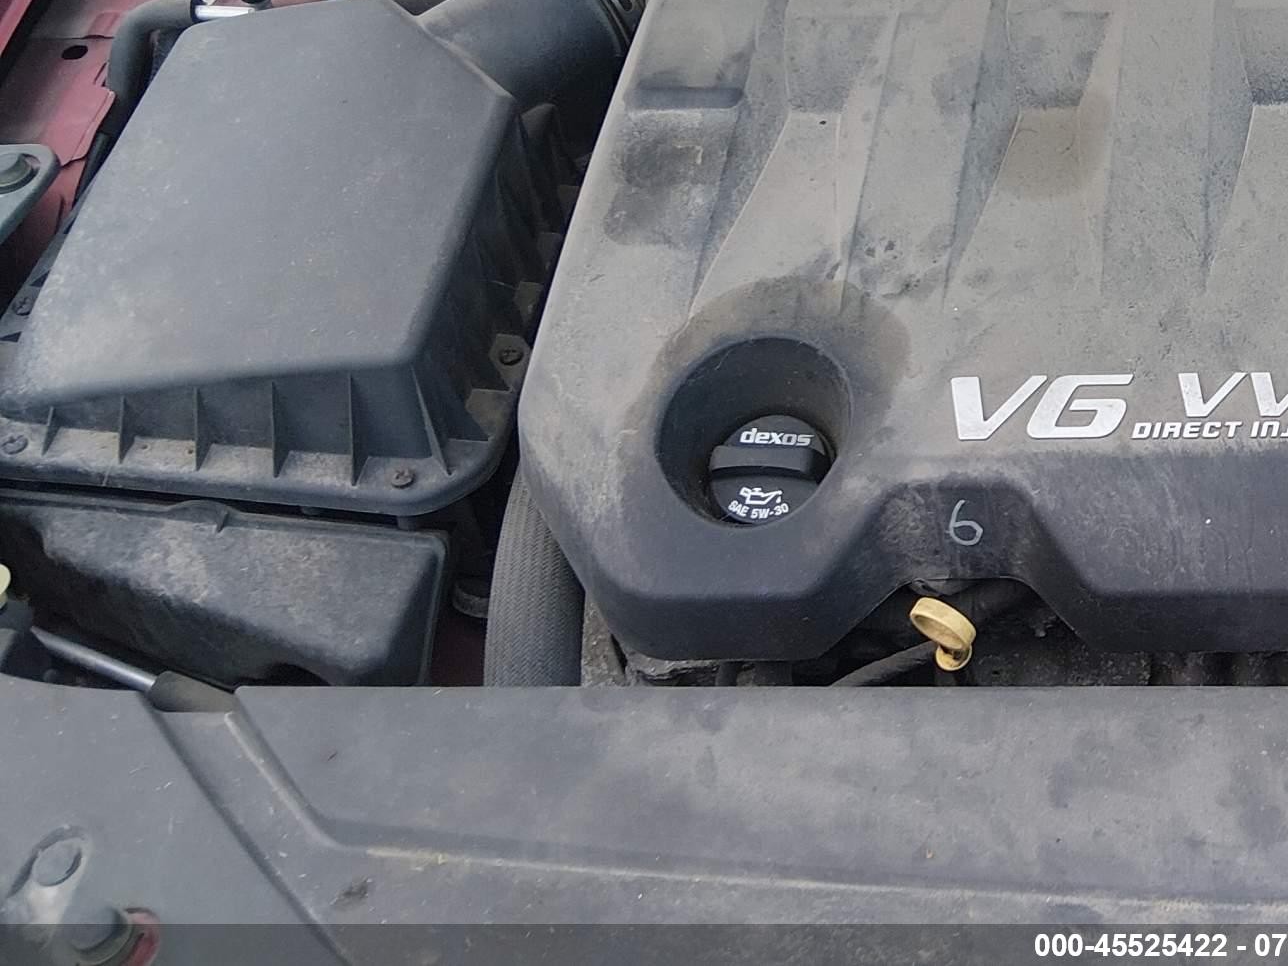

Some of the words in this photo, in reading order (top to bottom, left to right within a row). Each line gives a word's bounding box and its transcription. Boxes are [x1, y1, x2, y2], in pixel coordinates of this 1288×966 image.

[950, 372, 1135, 442] V6
[739, 427, 815, 447] dexos
[1130, 419, 1243, 440] DIRECT
[727, 499, 750, 519] SAE
[750, 502, 790, 520] 5W-30
[945, 499, 984, 546] 6
